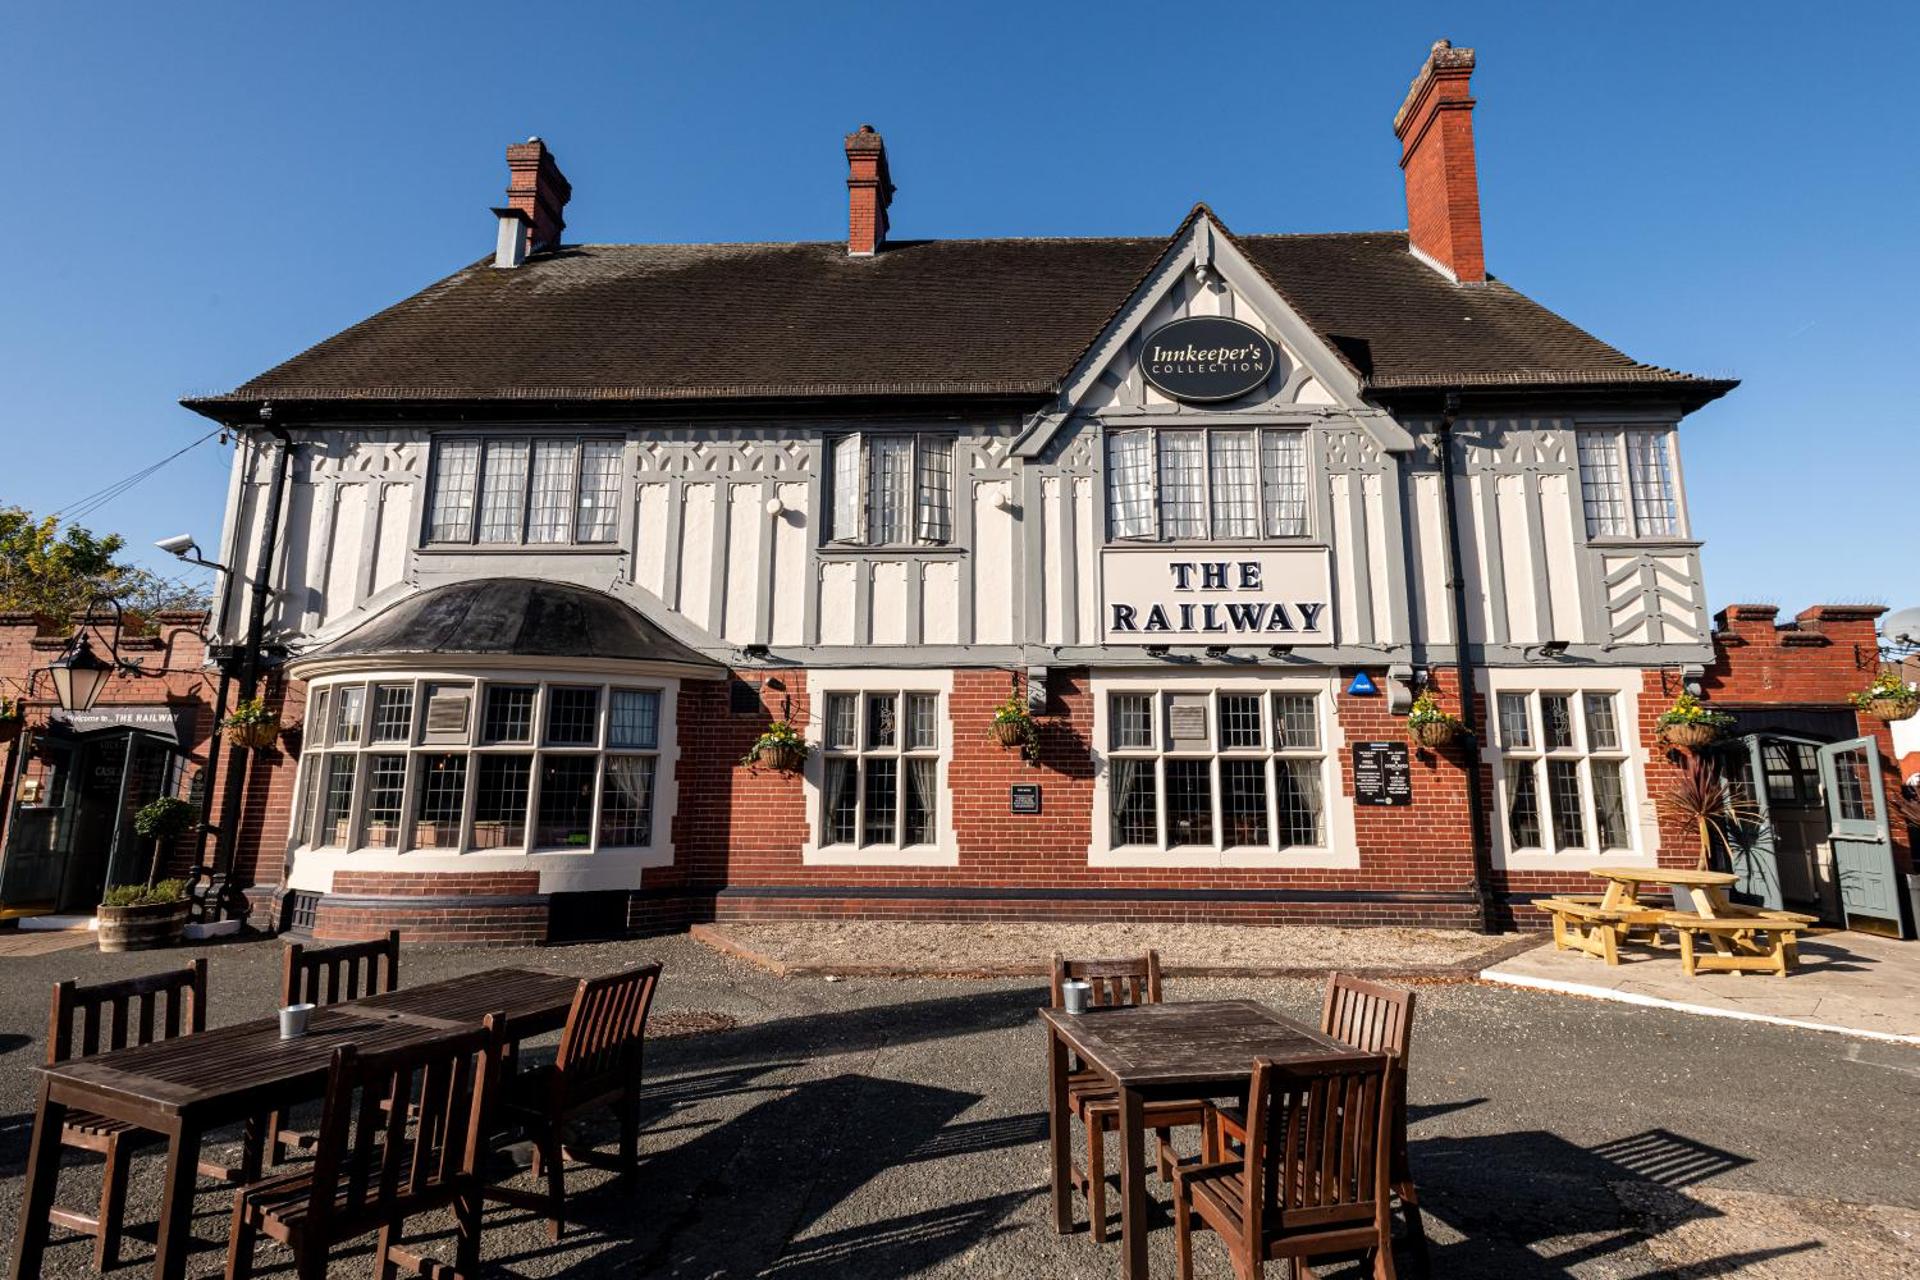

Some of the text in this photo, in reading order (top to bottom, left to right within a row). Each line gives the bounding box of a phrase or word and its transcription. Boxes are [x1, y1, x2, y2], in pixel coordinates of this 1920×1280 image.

[1152, 343, 1261, 364] Innkeeper's
[1152, 363, 1263, 373] COLLECTION
[1169, 561, 1263, 591] THE
[1110, 603, 1326, 634] RAILWAY
[67, 714, 99, 723] Welcome
[115, 713, 133, 722] THE
[136, 713, 179, 722] RAILWAY
